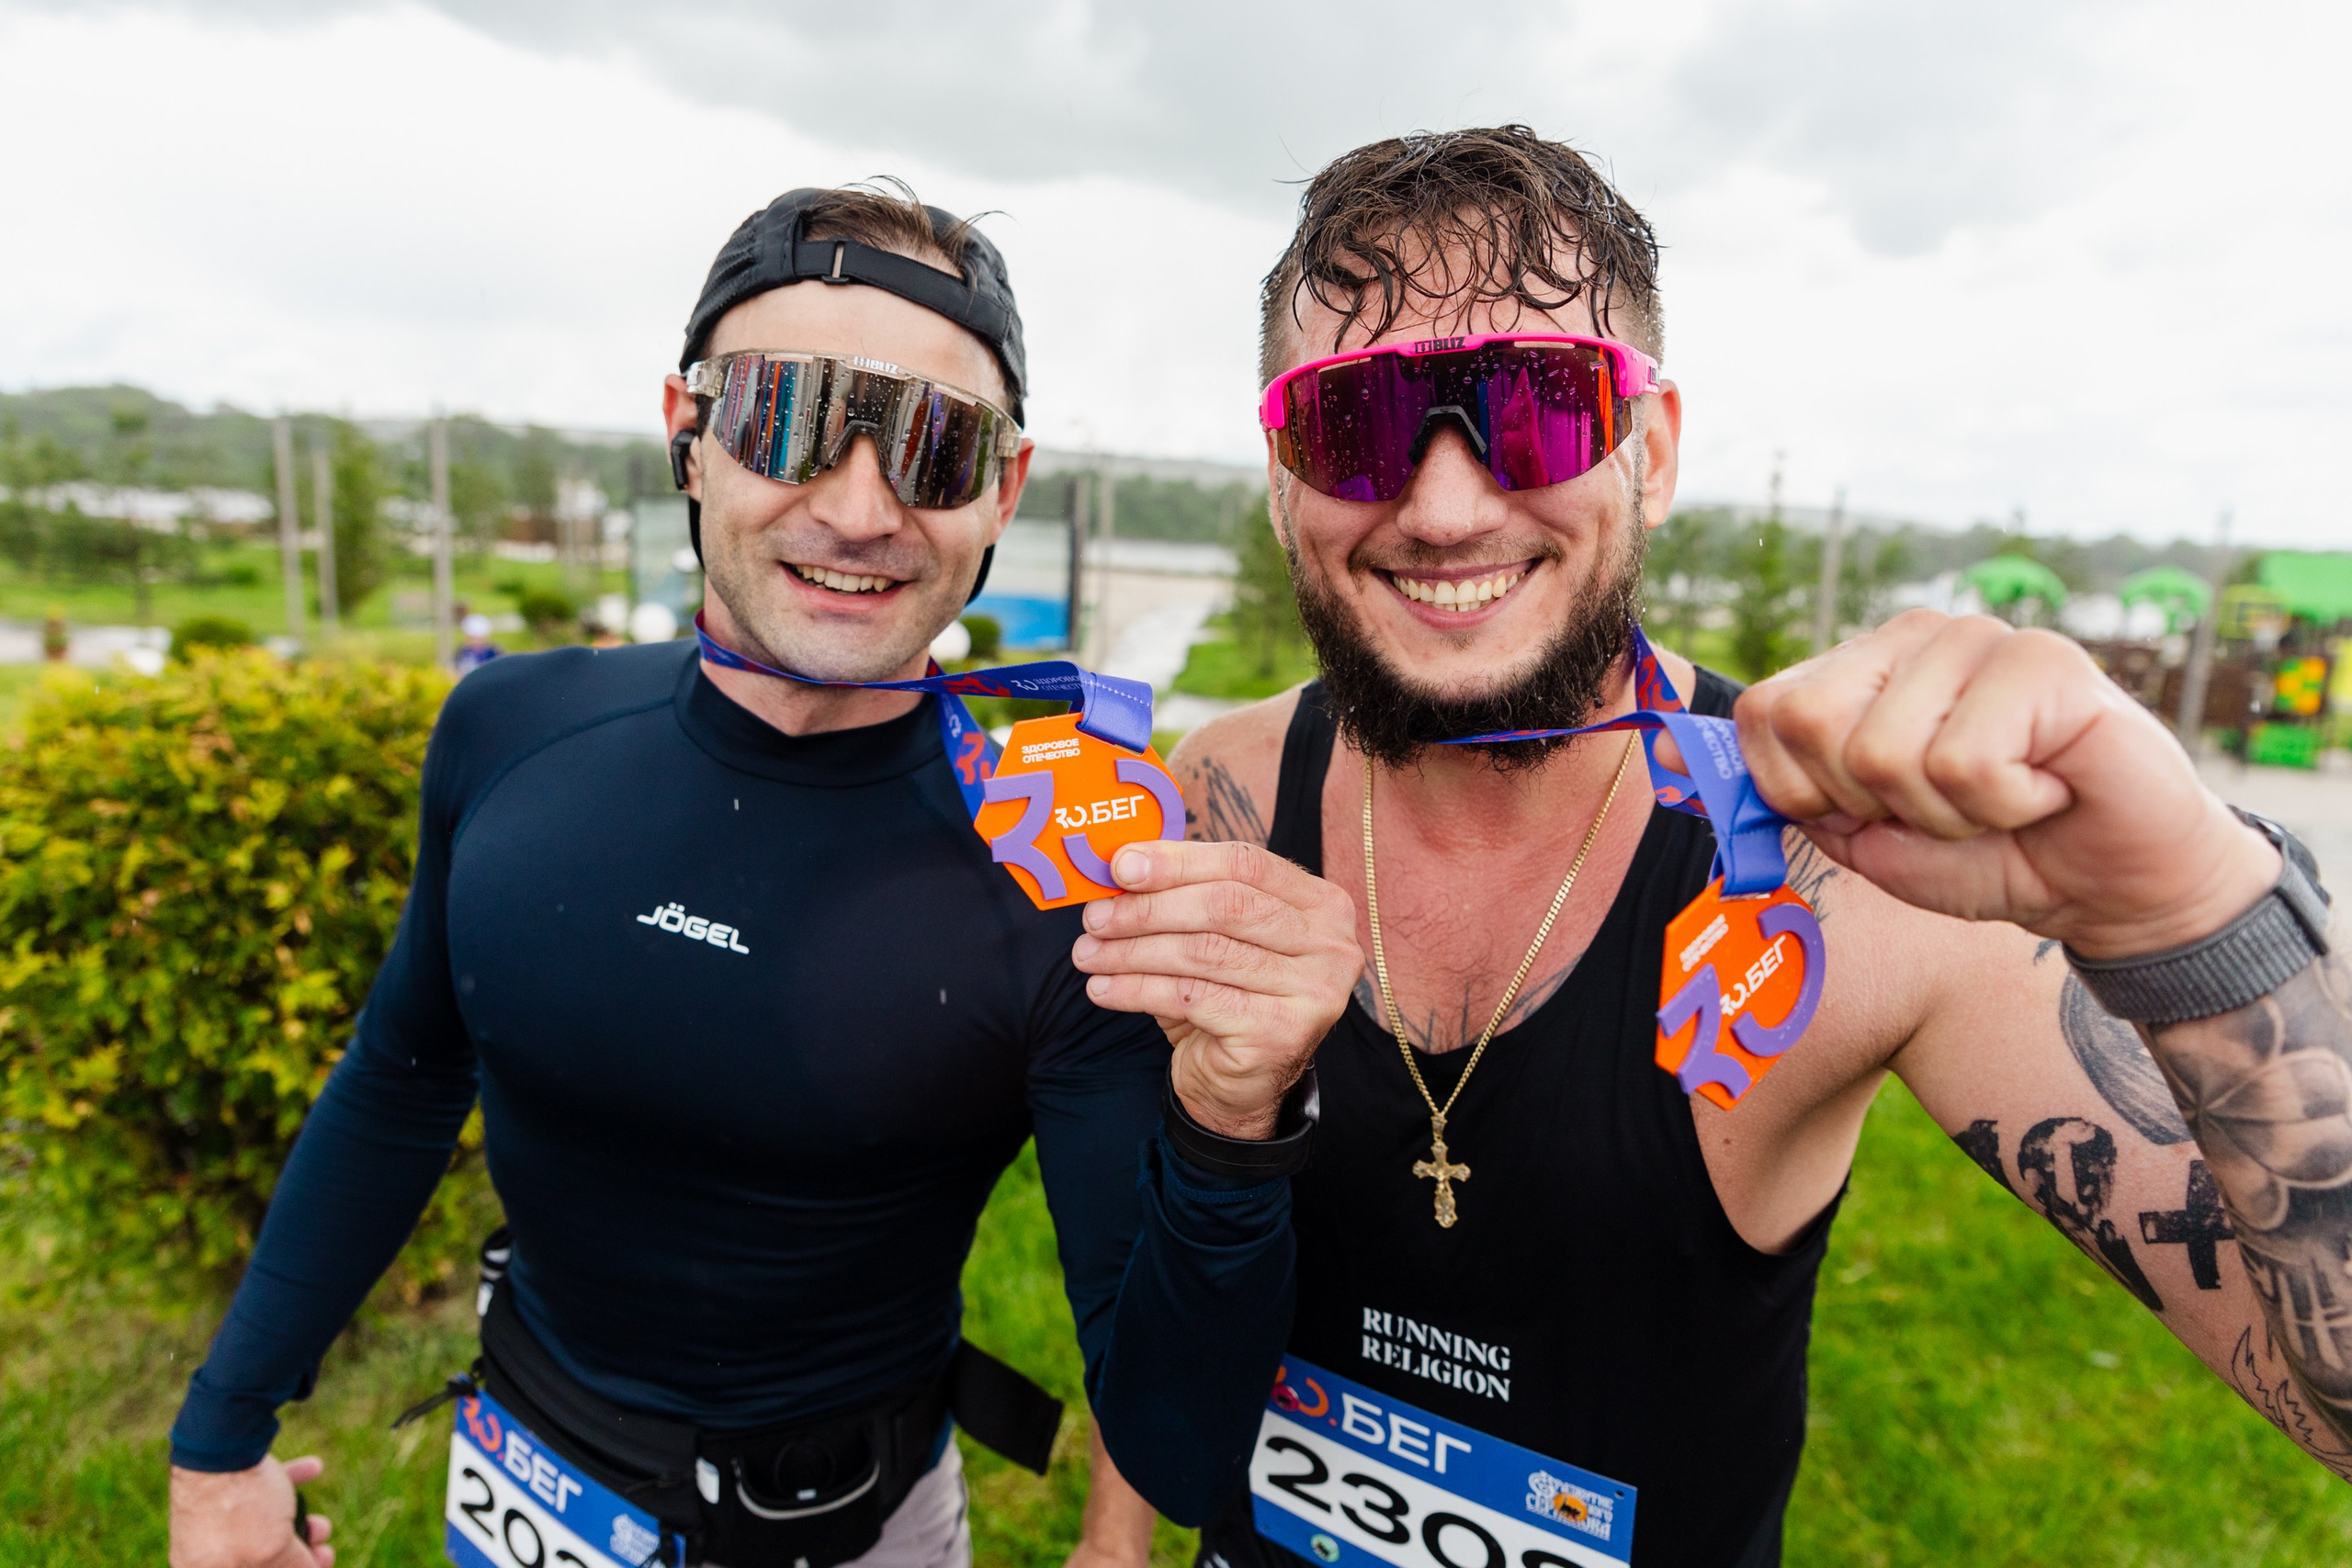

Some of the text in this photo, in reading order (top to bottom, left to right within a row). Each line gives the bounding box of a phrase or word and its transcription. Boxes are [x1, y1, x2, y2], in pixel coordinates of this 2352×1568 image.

[1433, 336, 1466, 352] BLIZ
[869, 359, 899, 375] BLIZ
[1035, 675, 1081, 685] ЗДОРОВО
[1021, 738, 1080, 754] ЗДОРОВОЕ
[1022, 748, 1080, 764] ОТЕЧЕСТВО
[636, 901, 751, 955] JÖGEL
[1363, 1306, 1511, 1371] RUNNING
[1362, 1335, 1511, 1403] RELIGION
[459, 1468, 589, 1568] 20
